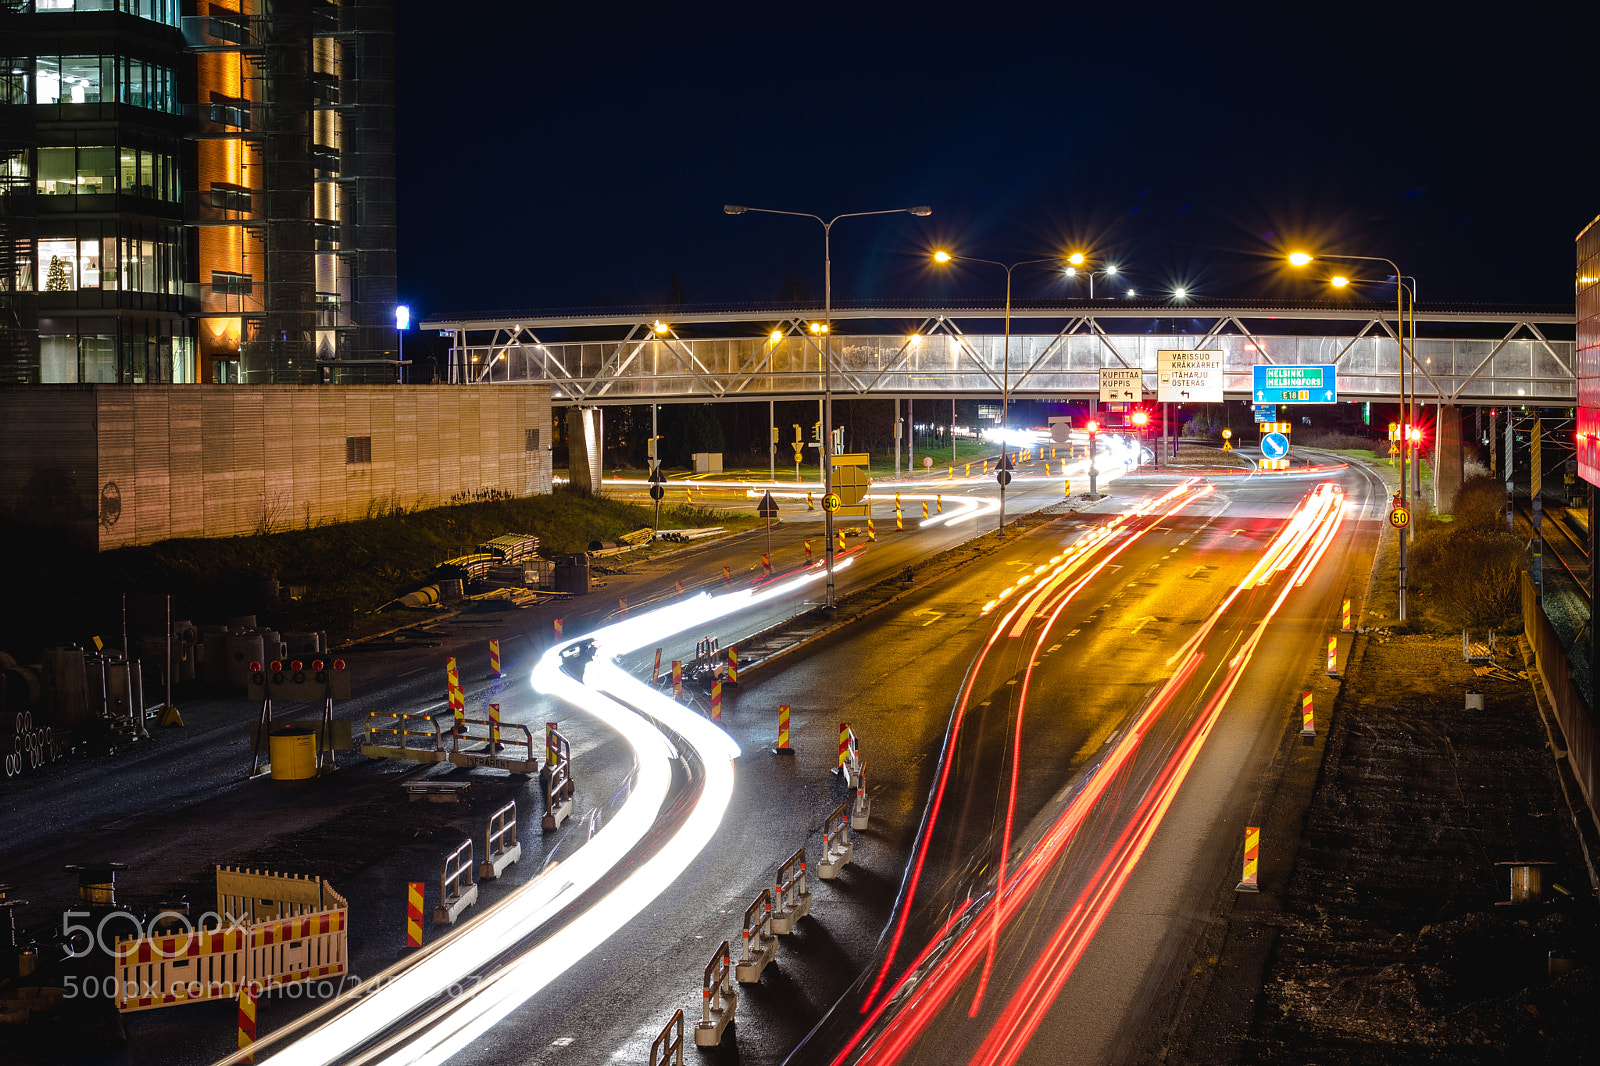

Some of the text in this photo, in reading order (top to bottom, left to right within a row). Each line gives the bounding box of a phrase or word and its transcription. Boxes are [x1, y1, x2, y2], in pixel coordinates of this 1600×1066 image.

[1102, 371, 1139, 379] KUPITTAA
[1102, 380, 1131, 388] KUPPIS
[825, 498, 837, 508] 50
[1394, 513, 1406, 524] 50
